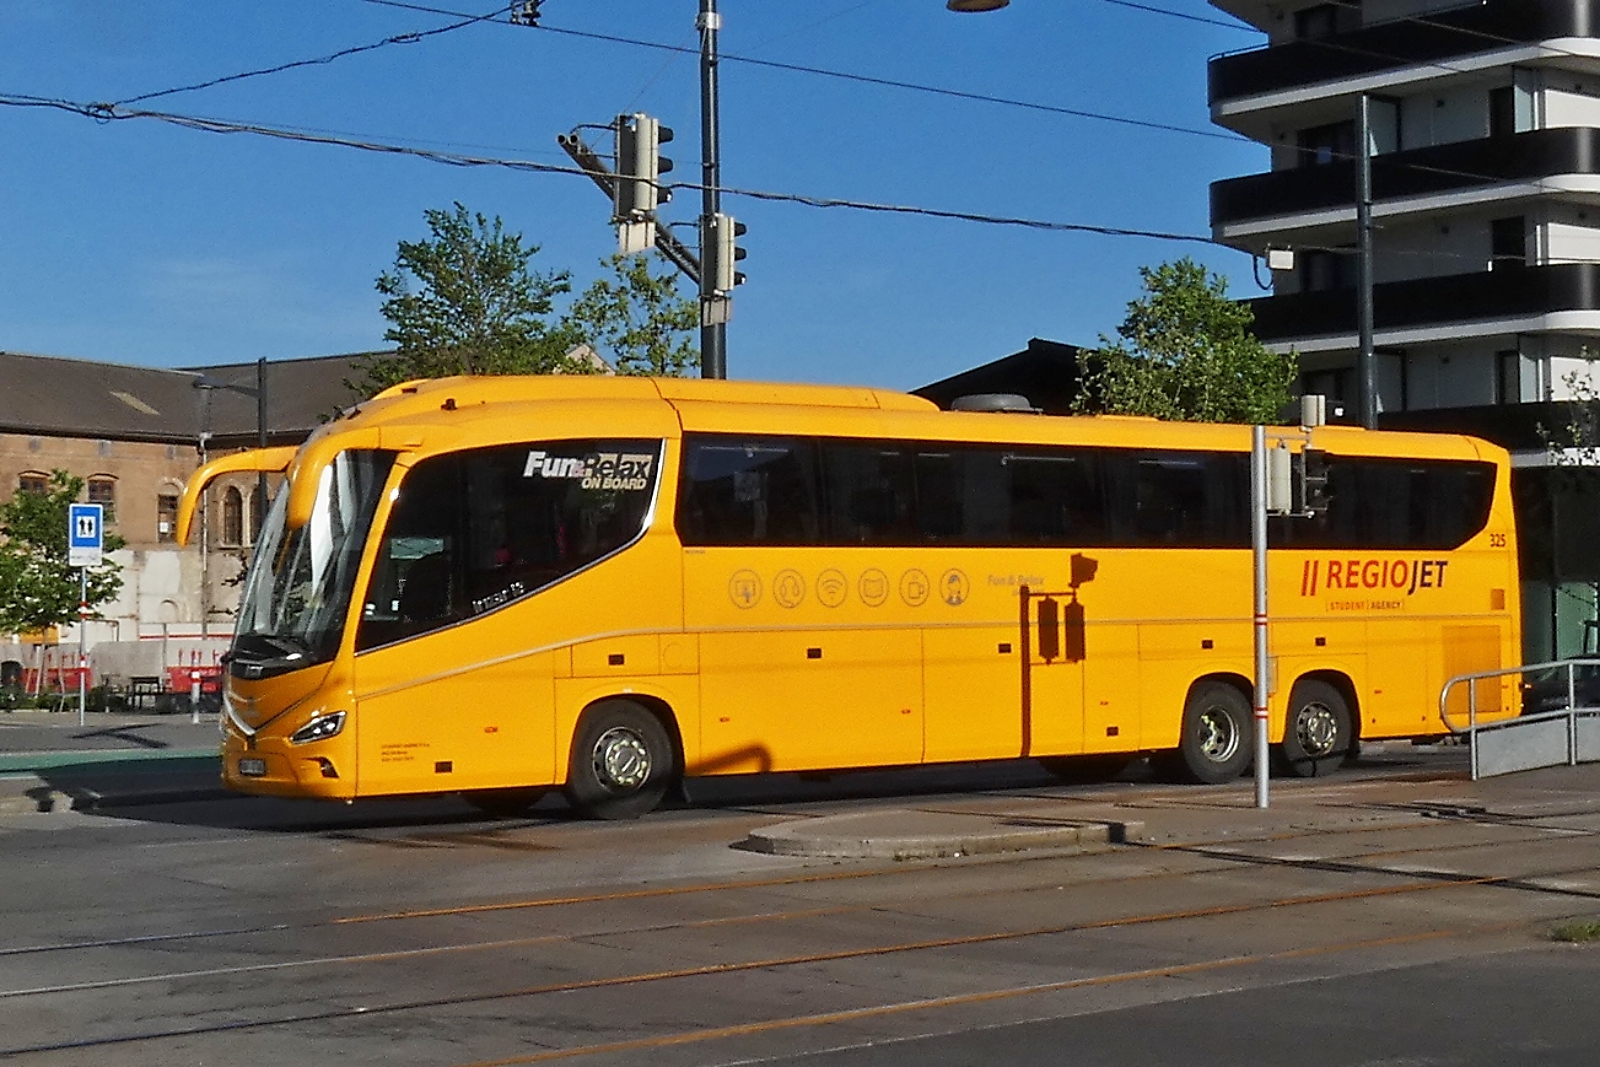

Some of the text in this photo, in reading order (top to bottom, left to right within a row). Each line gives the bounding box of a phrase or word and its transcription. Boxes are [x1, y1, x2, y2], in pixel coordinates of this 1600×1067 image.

[523, 451, 576, 478] Fun
[582, 477, 647, 490] ON BOARD
[1490, 534, 1506, 547] 325
[1326, 560, 1448, 595] REGIOJET
[1330, 601, 1401, 611] STUDENT AGENCY
